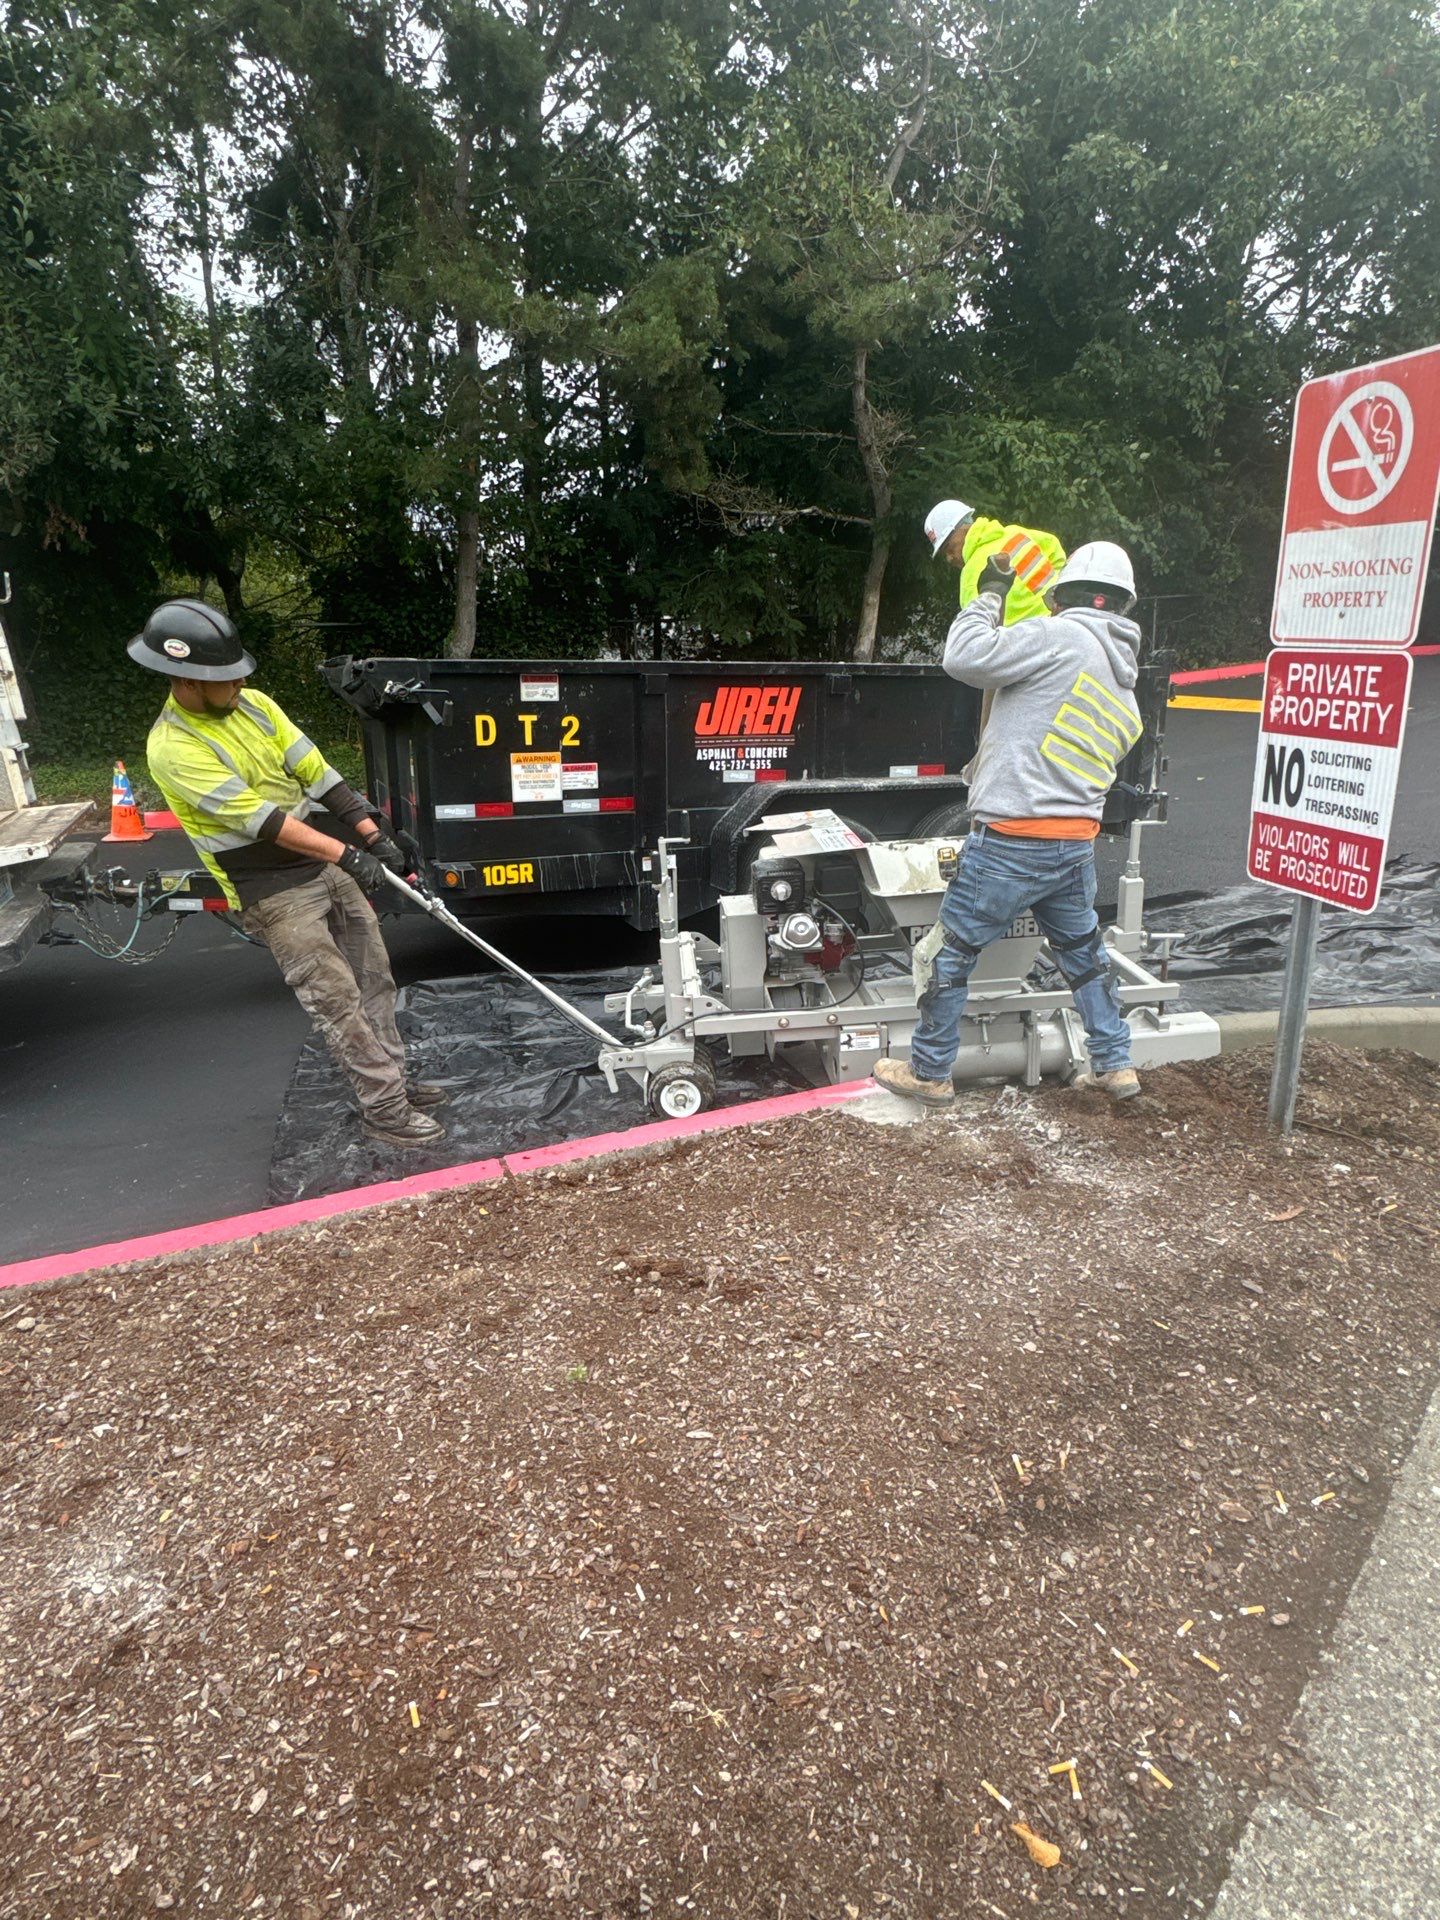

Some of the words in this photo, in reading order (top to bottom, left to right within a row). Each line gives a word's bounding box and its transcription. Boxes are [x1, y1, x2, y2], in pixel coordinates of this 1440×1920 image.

[1288, 557, 1413, 580] NON-SMOKING
[1302, 590, 1387, 609] PROPERTY
[1286, 663, 1382, 698] PRIVATE
[695, 687, 802, 734] JIREH
[1269, 694, 1394, 735] PROPERTY
[475, 714, 497, 746] D
[518, 714, 538, 746] T
[561, 715, 580, 746] 2
[521, 755, 557, 763] WARNING
[696, 748, 736, 760] ASPHALT
[737, 747, 744, 759] &
[745, 747, 788, 759] CONCRETE
[709, 760, 771, 771] 425-737-6355
[1310, 750, 1372, 772] SOLICITING
[1262, 744, 1305, 808] NO
[1307, 775, 1365, 796] LOITERING
[1305, 798, 1379, 826] TRESPASSING
[1258, 822, 1330, 861] VIOLATORS
[1338, 841, 1371, 872] WILL
[483, 863, 534, 886] 10SR
[1254, 848, 1271, 873] BE
[1279, 857, 1368, 900] PROSECUTED
